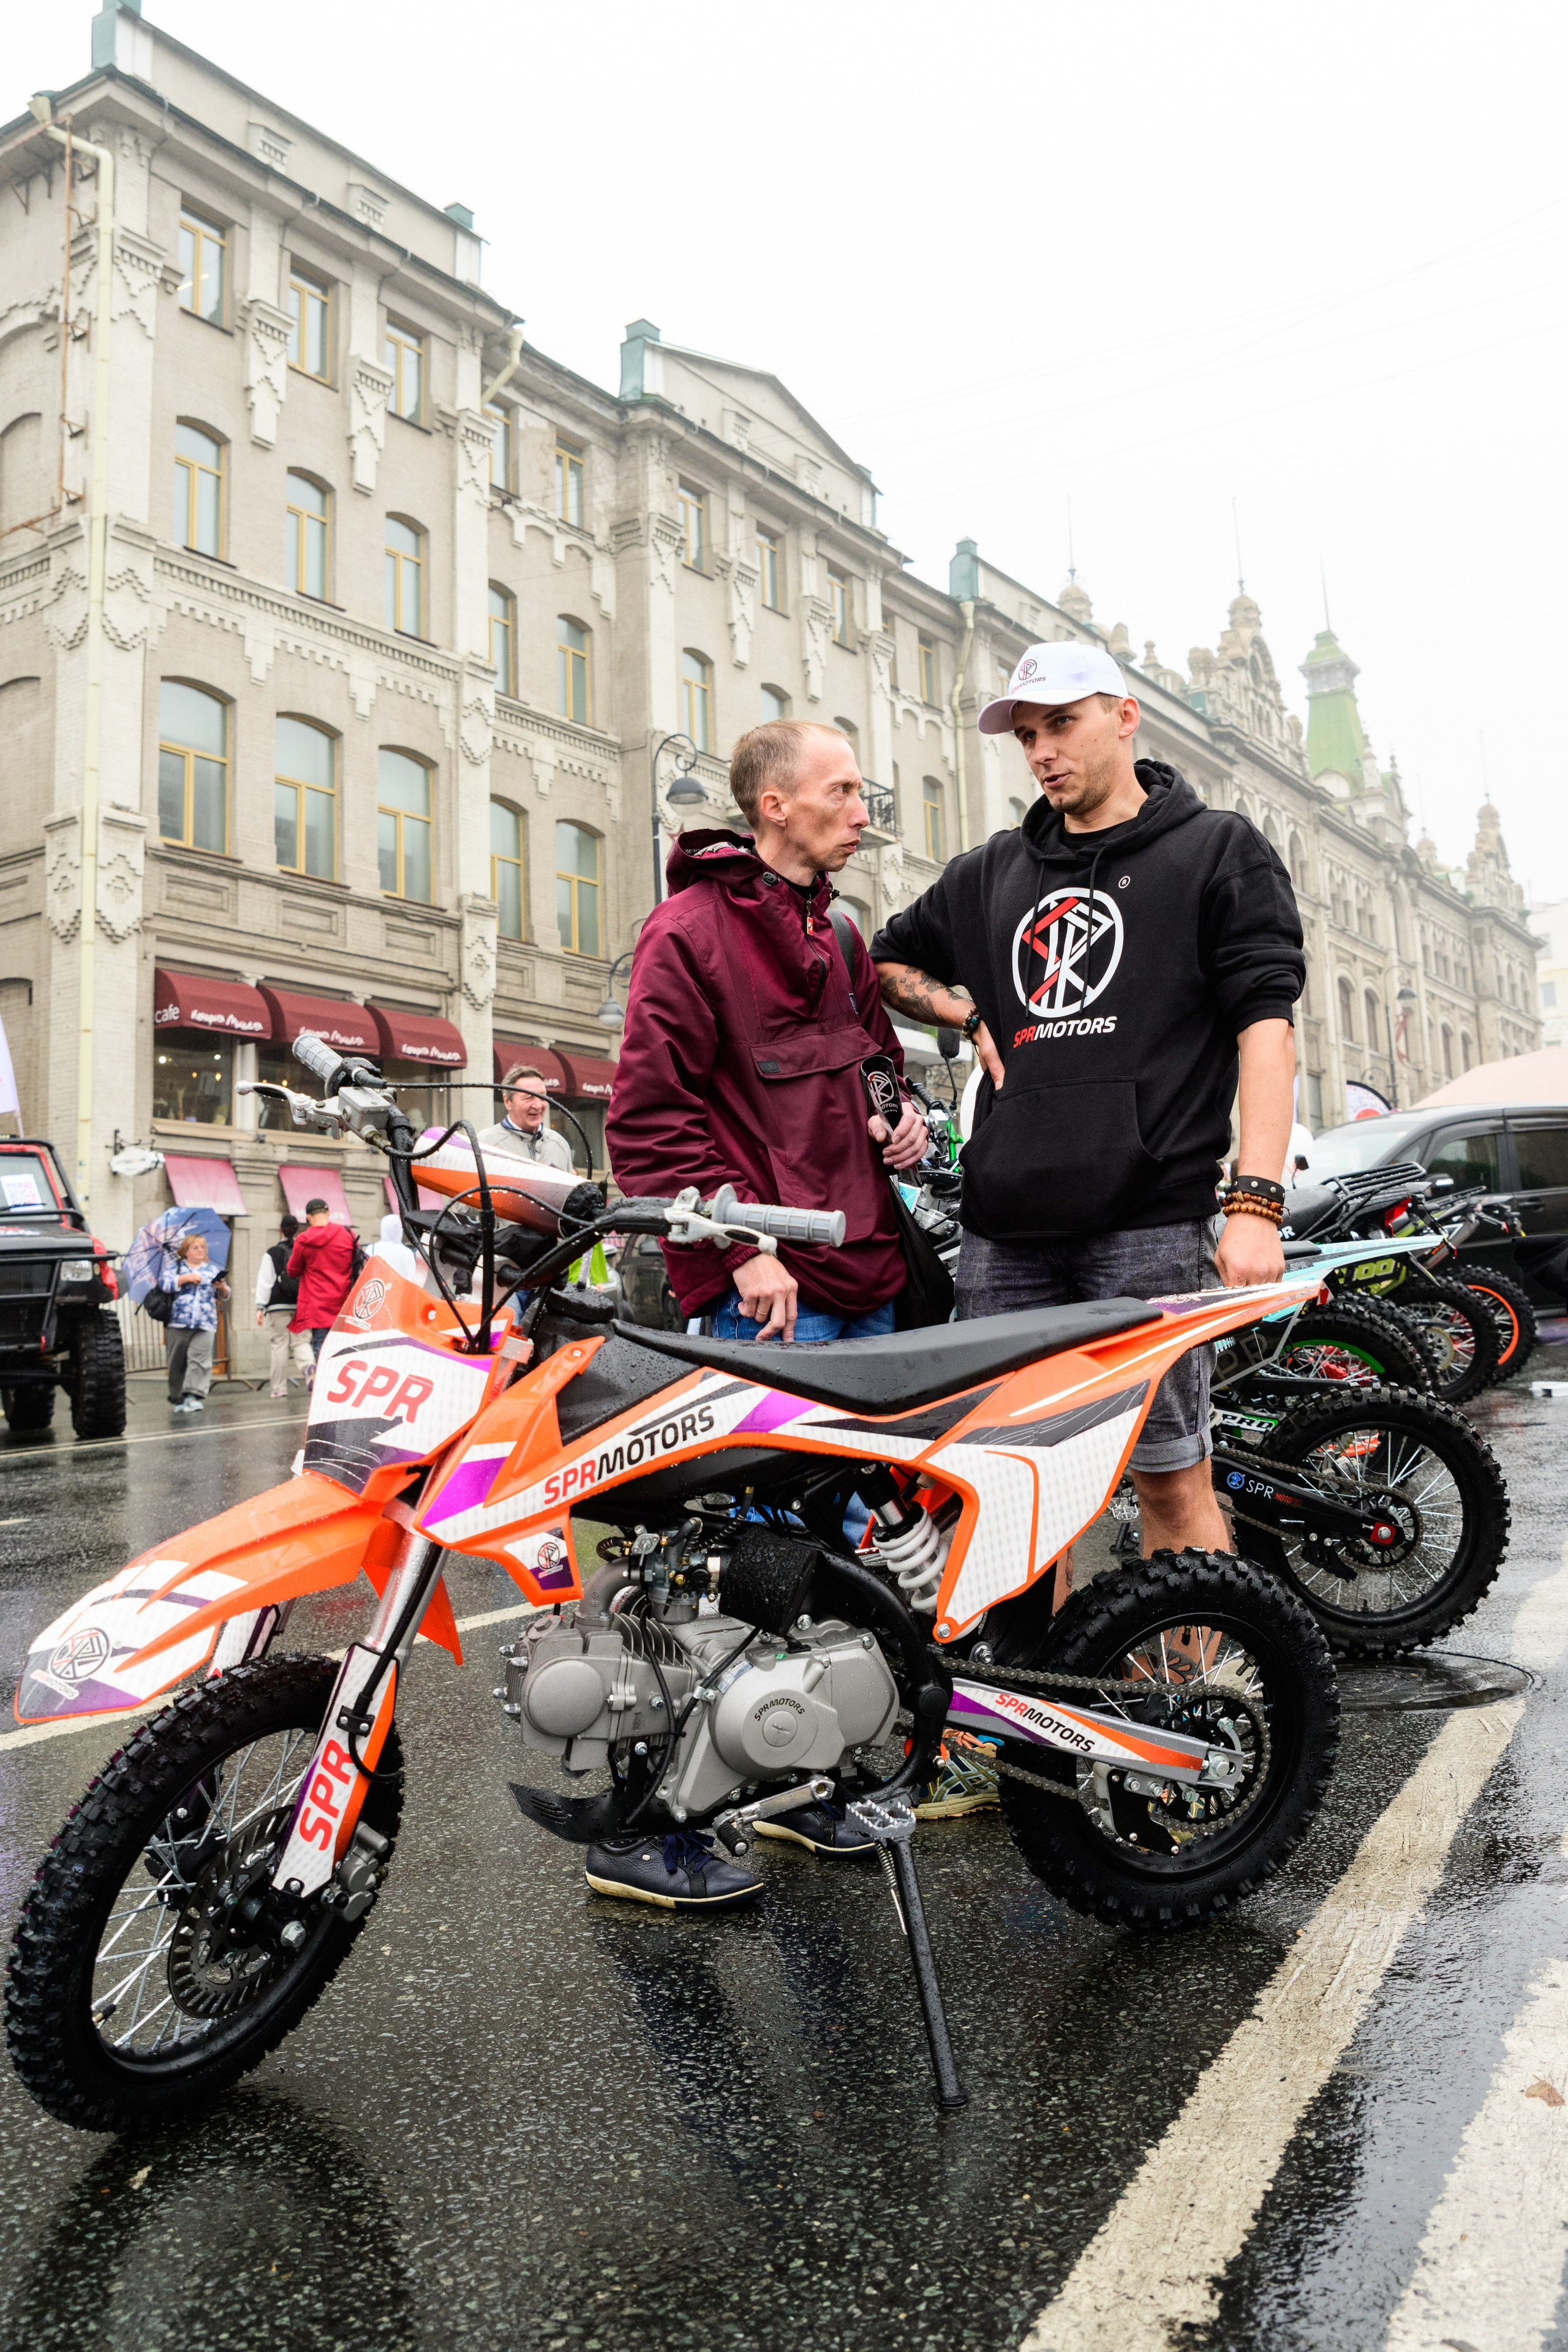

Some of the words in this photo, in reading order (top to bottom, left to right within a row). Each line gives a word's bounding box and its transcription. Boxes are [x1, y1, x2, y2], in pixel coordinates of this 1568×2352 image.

[154, 1003, 180, 1023] cafe
[1013, 1016, 1117, 1048] SPRMOTORS
[1289, 1261, 1308, 1271] SPR
[326, 1360, 434, 1423] SPR
[544, 1405, 714, 1505] SPRMOTORS
[1246, 1480, 1273, 1499] SPR
[31, 1670, 77, 1698] SPRMOTORS
[755, 1698, 805, 1721] SPRMOTORS
[995, 1694, 1095, 1752] SPRMOTORS
[300, 1739, 355, 1851] SPR
